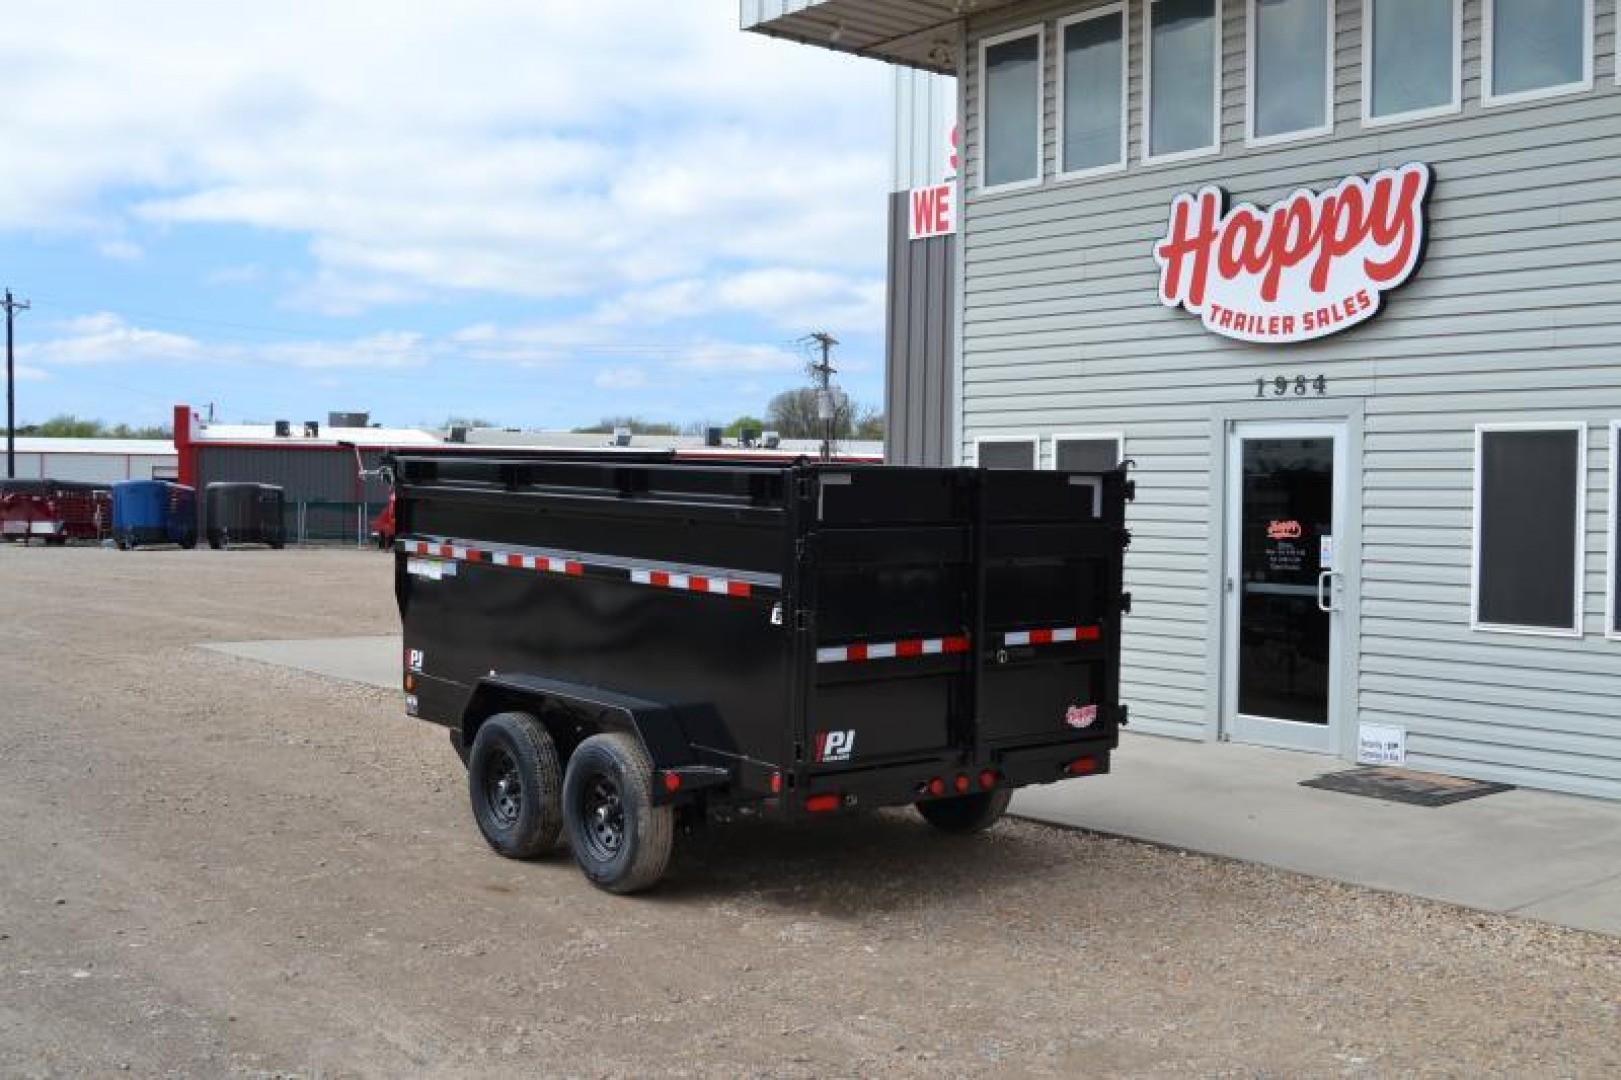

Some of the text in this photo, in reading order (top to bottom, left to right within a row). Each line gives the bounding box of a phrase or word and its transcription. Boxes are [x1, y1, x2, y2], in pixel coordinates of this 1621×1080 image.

[913, 185, 949, 236] WE
[1158, 171, 1421, 306] Happy
[1210, 289, 1371, 335] TRAILER SALES
[1255, 374, 1327, 397] 1984
[409, 649, 424, 667] PJ
[824, 729, 855, 755] PJ
